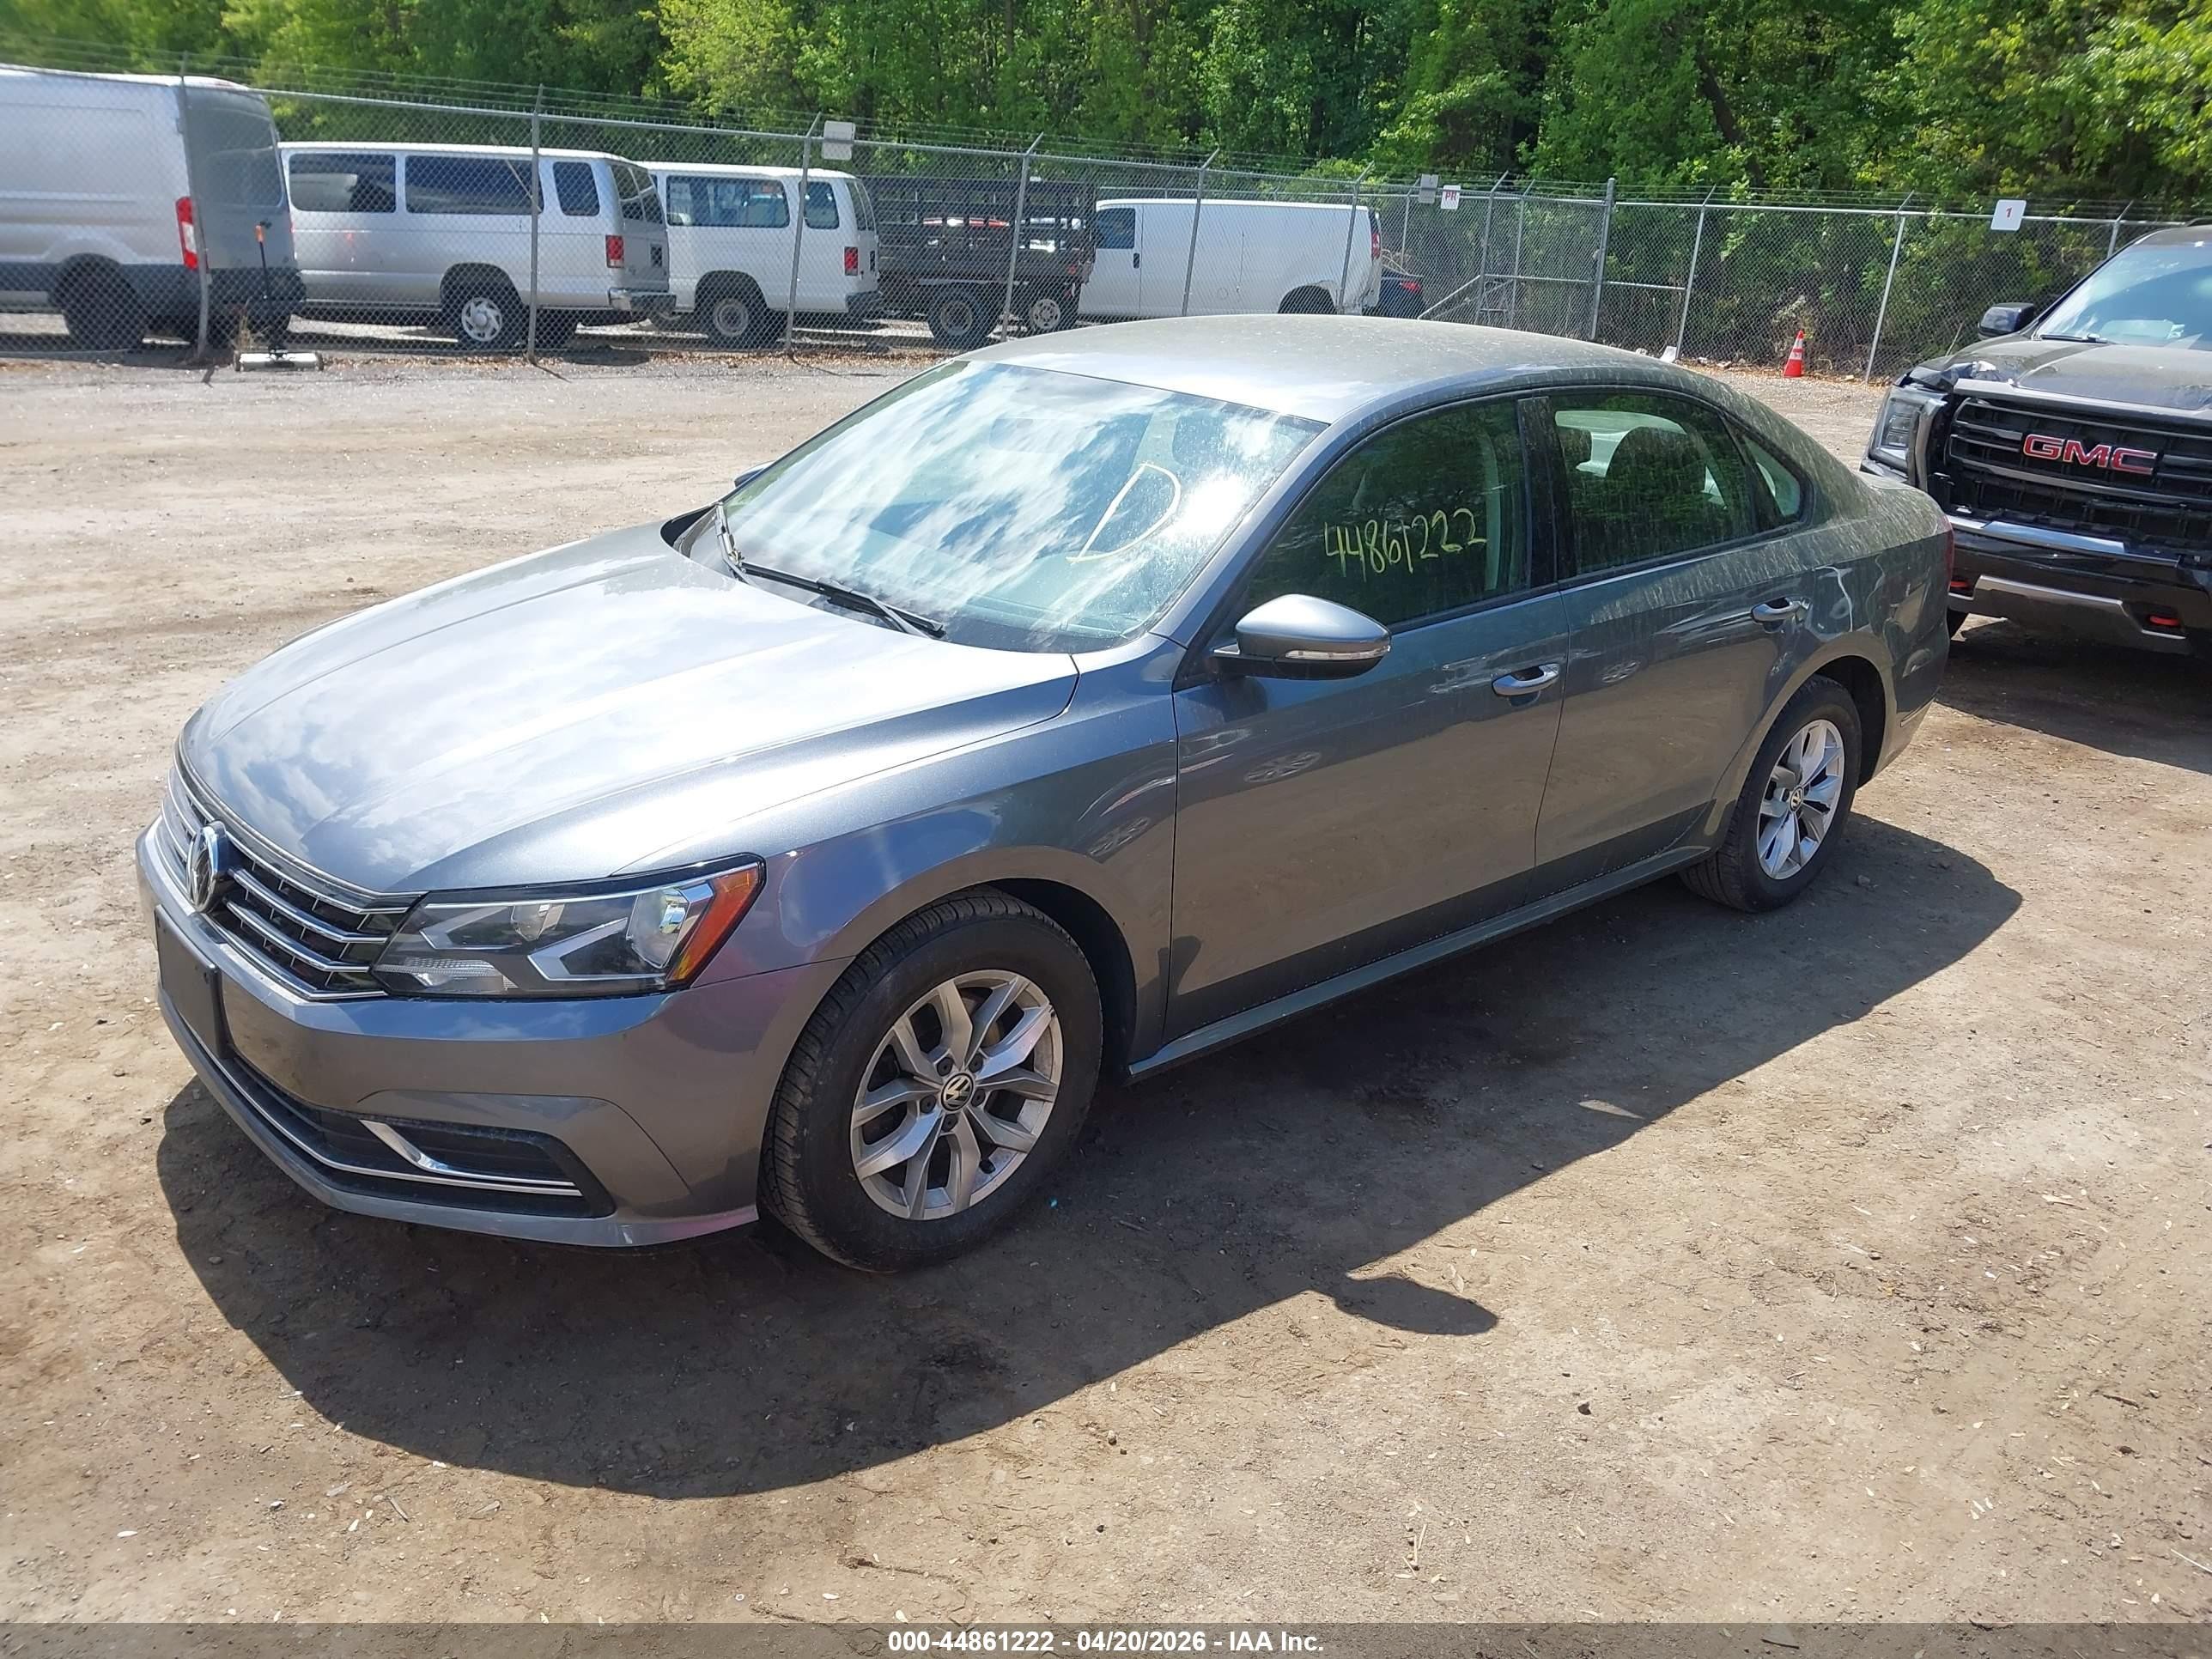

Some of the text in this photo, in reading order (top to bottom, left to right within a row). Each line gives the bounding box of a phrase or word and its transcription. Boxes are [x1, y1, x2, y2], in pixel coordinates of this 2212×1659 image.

[2005, 207, 2013, 218] 1
[2023, 434, 2157, 475] GMC
[1324, 507, 1487, 582] 44861222
